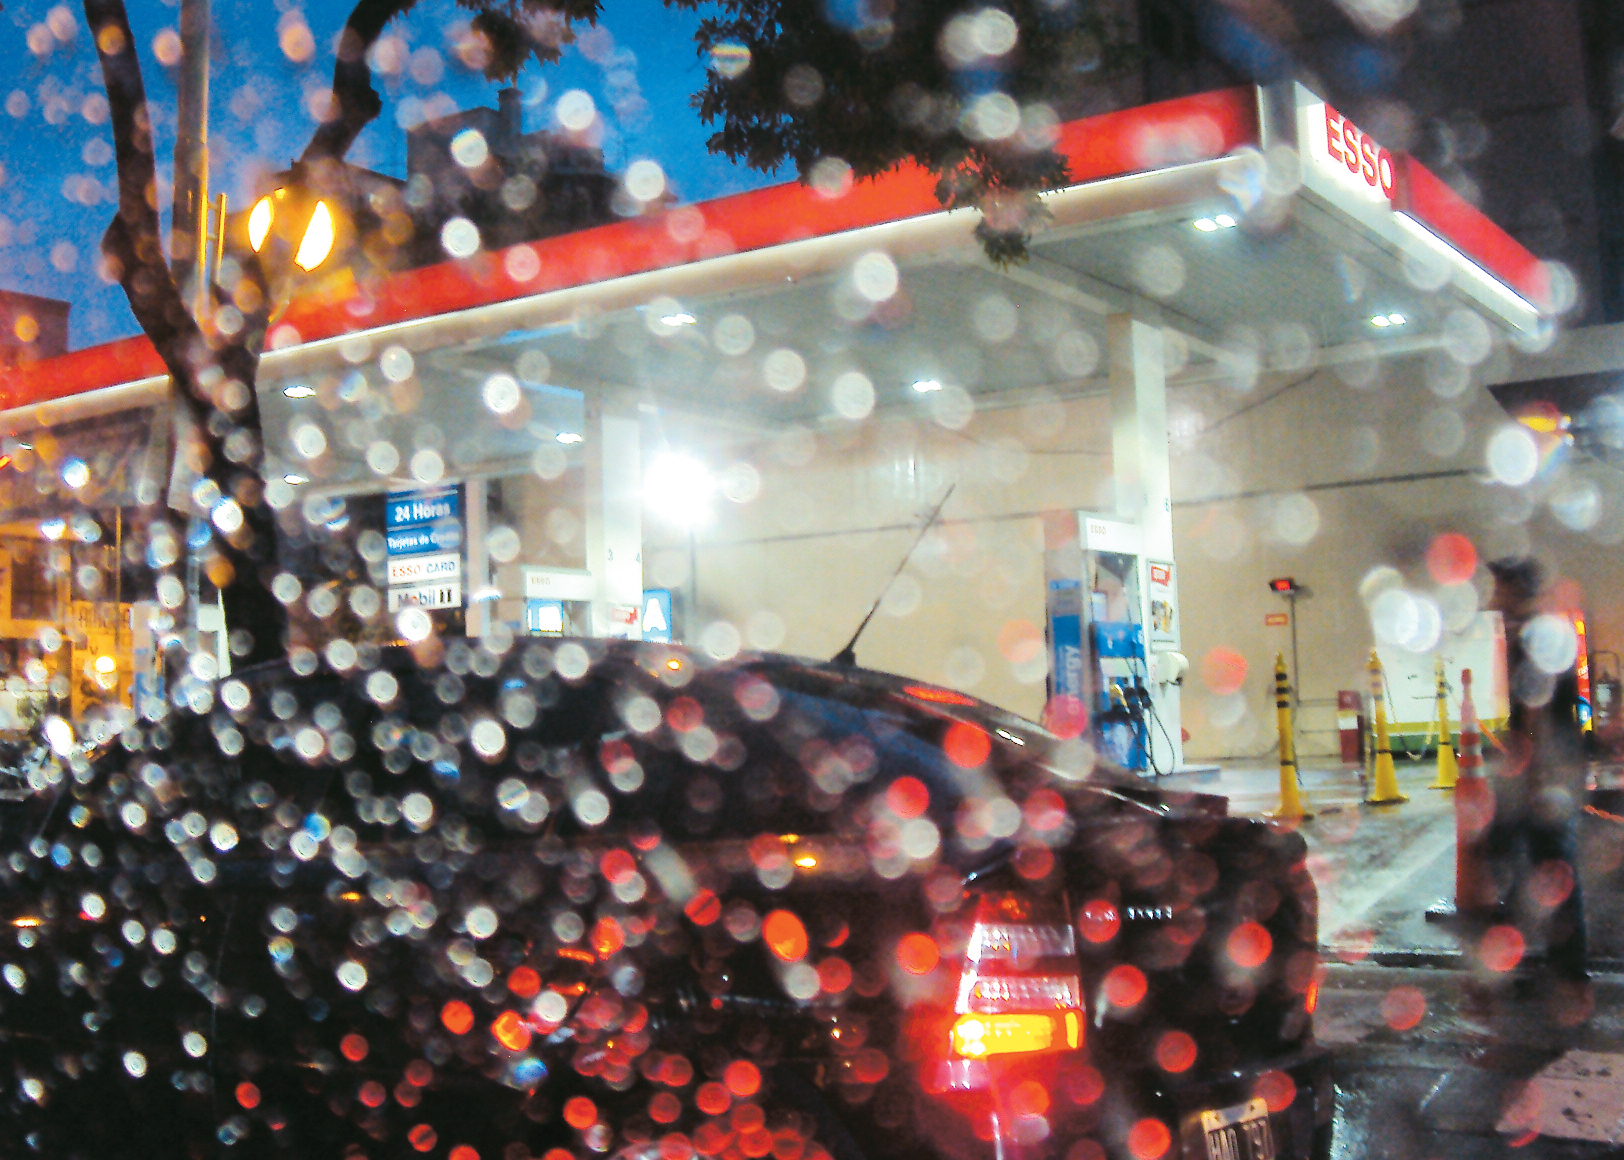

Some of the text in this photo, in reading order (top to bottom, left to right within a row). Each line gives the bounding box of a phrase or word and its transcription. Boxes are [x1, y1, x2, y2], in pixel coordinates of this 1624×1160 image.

[1324, 102, 1397, 201] ESSO
[394, 502, 451, 523] 24 Horas
[418, 533, 430, 546] de
[392, 560, 456, 579] ESSO CARD
[397, 588, 436, 608] Mobil
